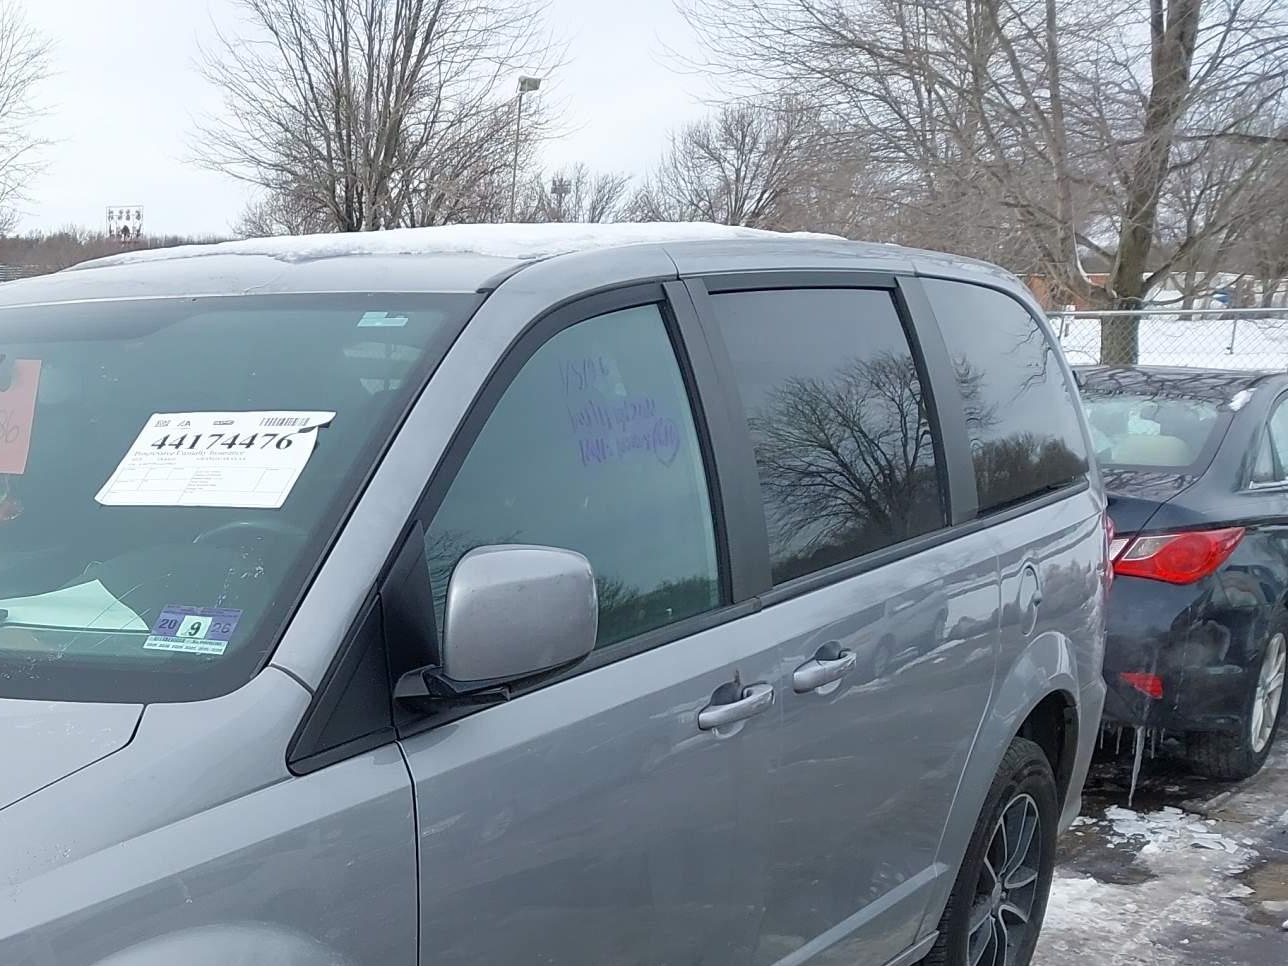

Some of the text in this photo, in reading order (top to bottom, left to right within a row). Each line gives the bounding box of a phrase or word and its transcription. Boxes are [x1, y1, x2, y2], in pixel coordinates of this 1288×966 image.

[151, 433, 293, 450] 44174476
[158, 618, 232, 637] 20 9 26
